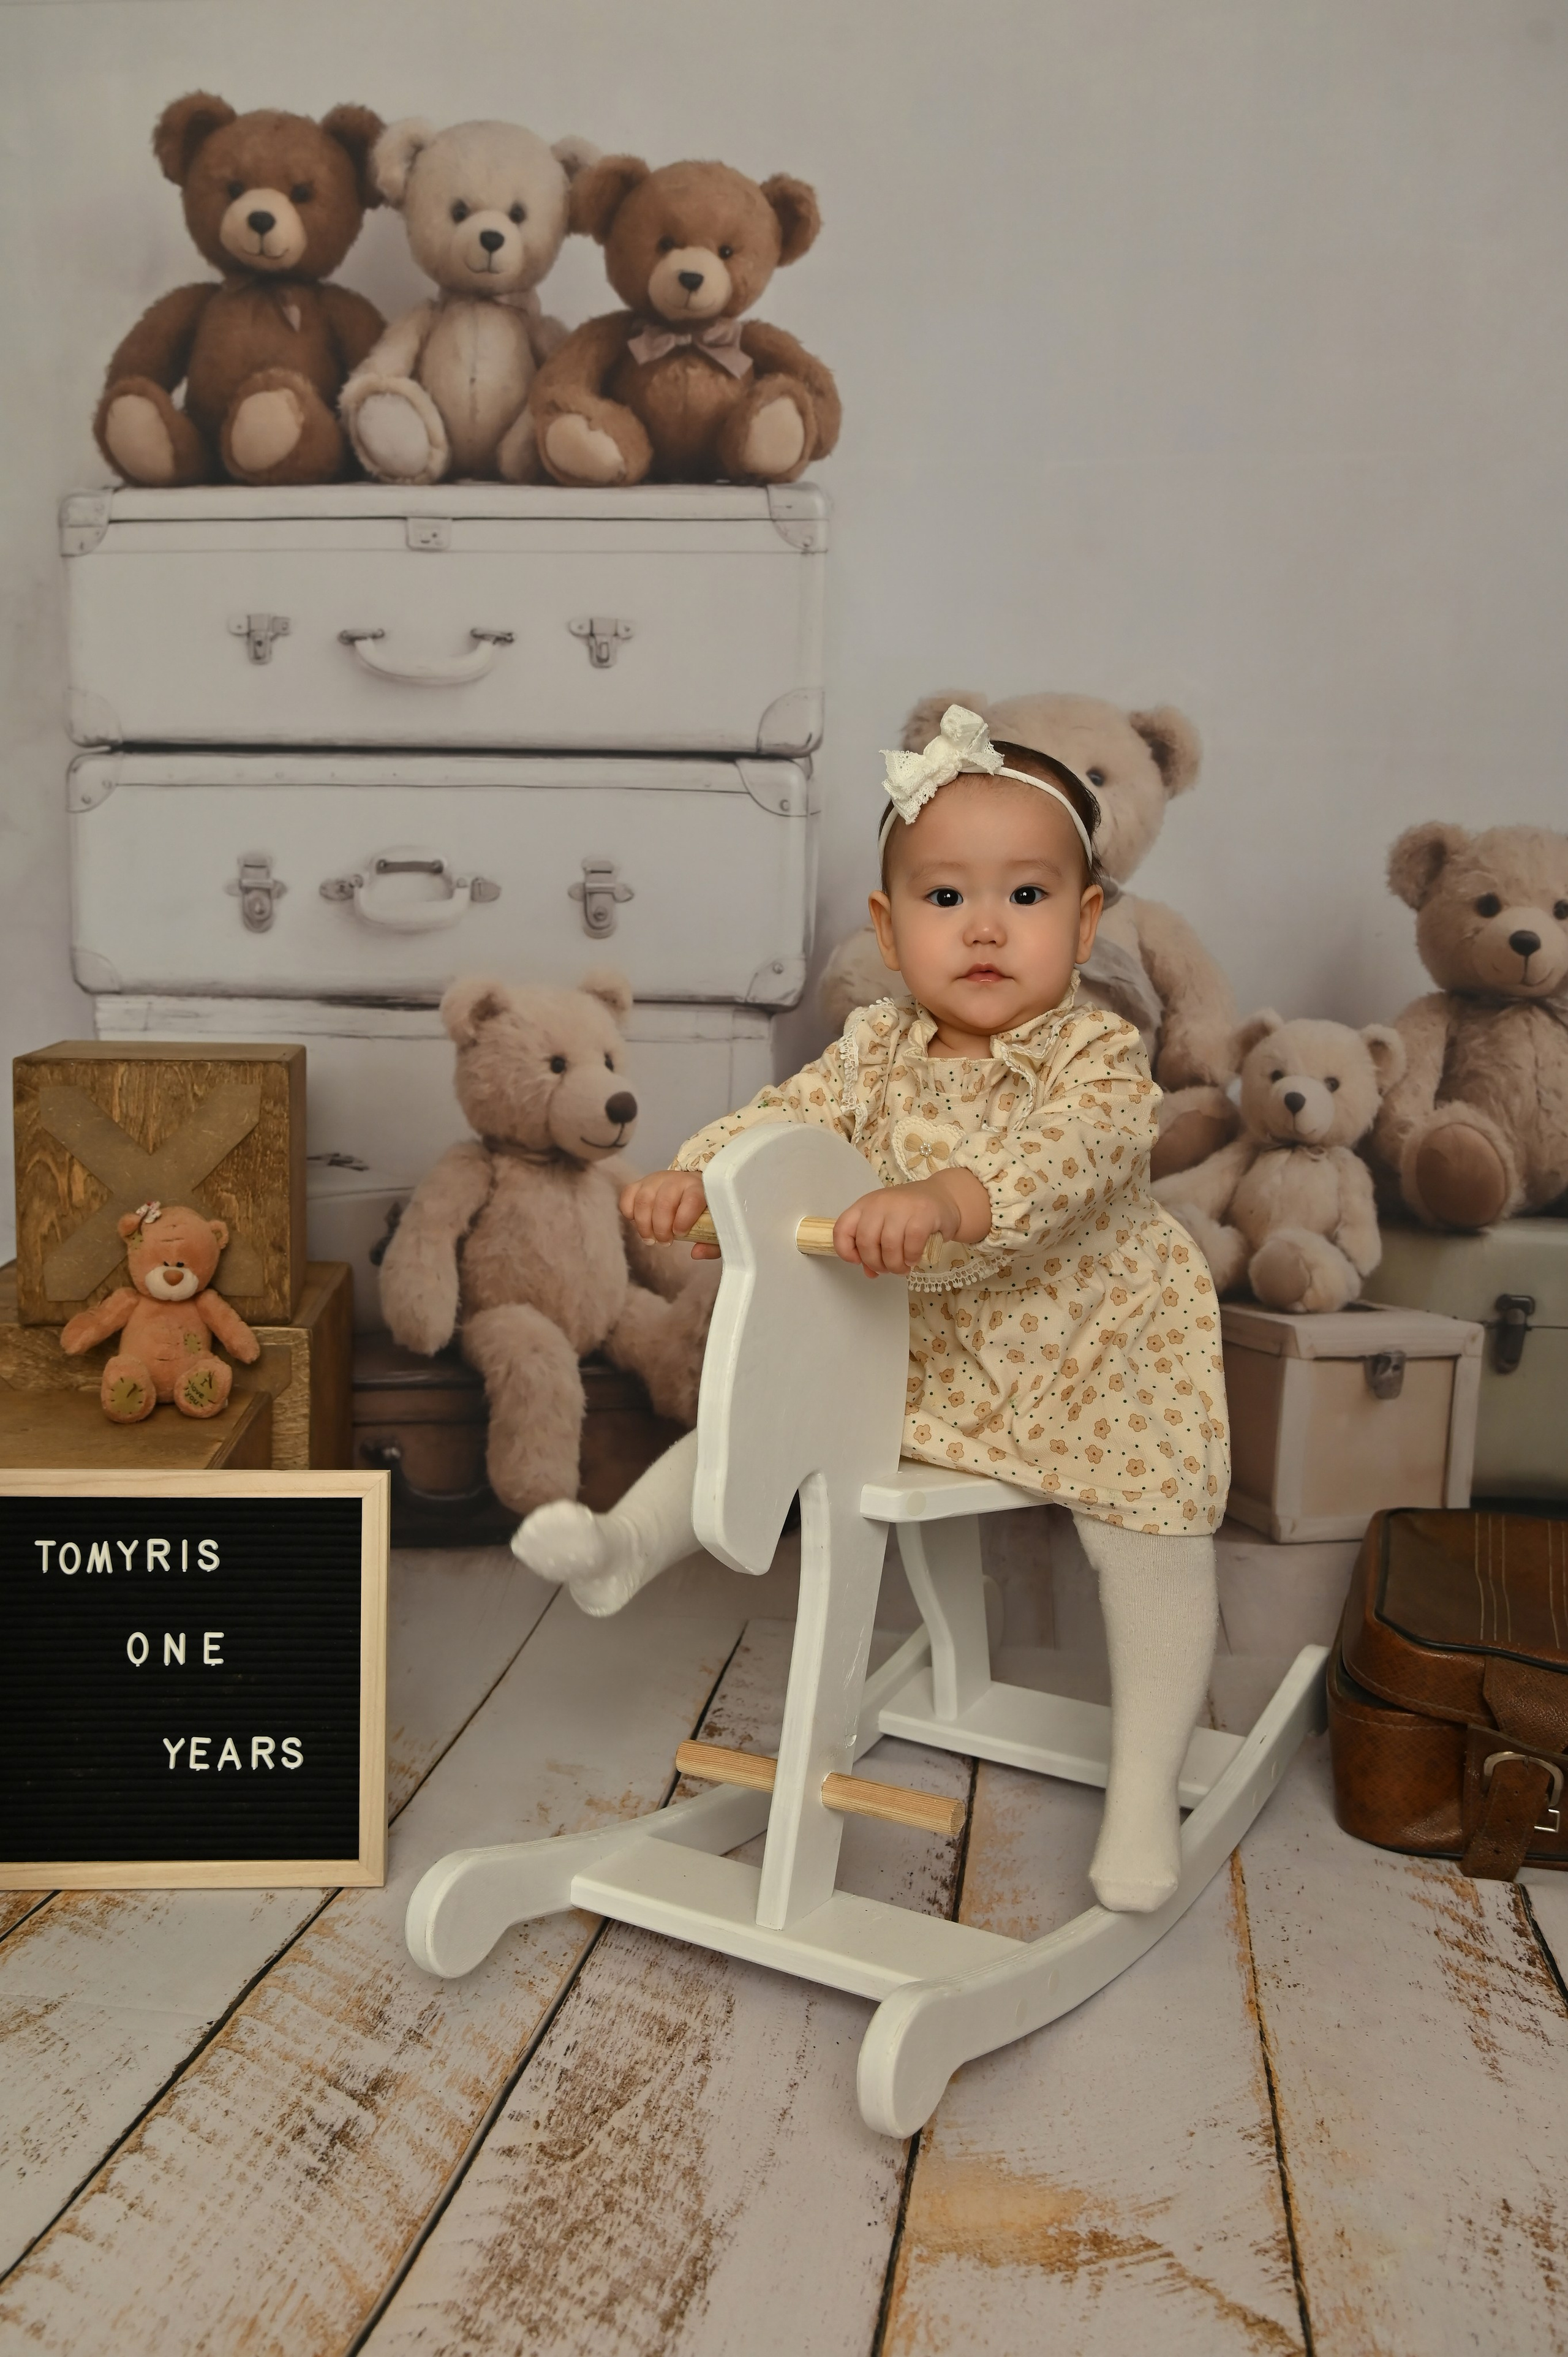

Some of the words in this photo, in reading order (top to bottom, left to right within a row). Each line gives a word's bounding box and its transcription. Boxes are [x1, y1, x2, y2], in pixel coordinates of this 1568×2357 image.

[190, 1382, 205, 1399] love
[200, 1378, 208, 1387] I
[185, 1390, 199, 1405] you
[34, 1538, 220, 1575] TOMYRIS
[127, 1632, 225, 1667] ONE
[162, 1737, 304, 1771] YEARS
